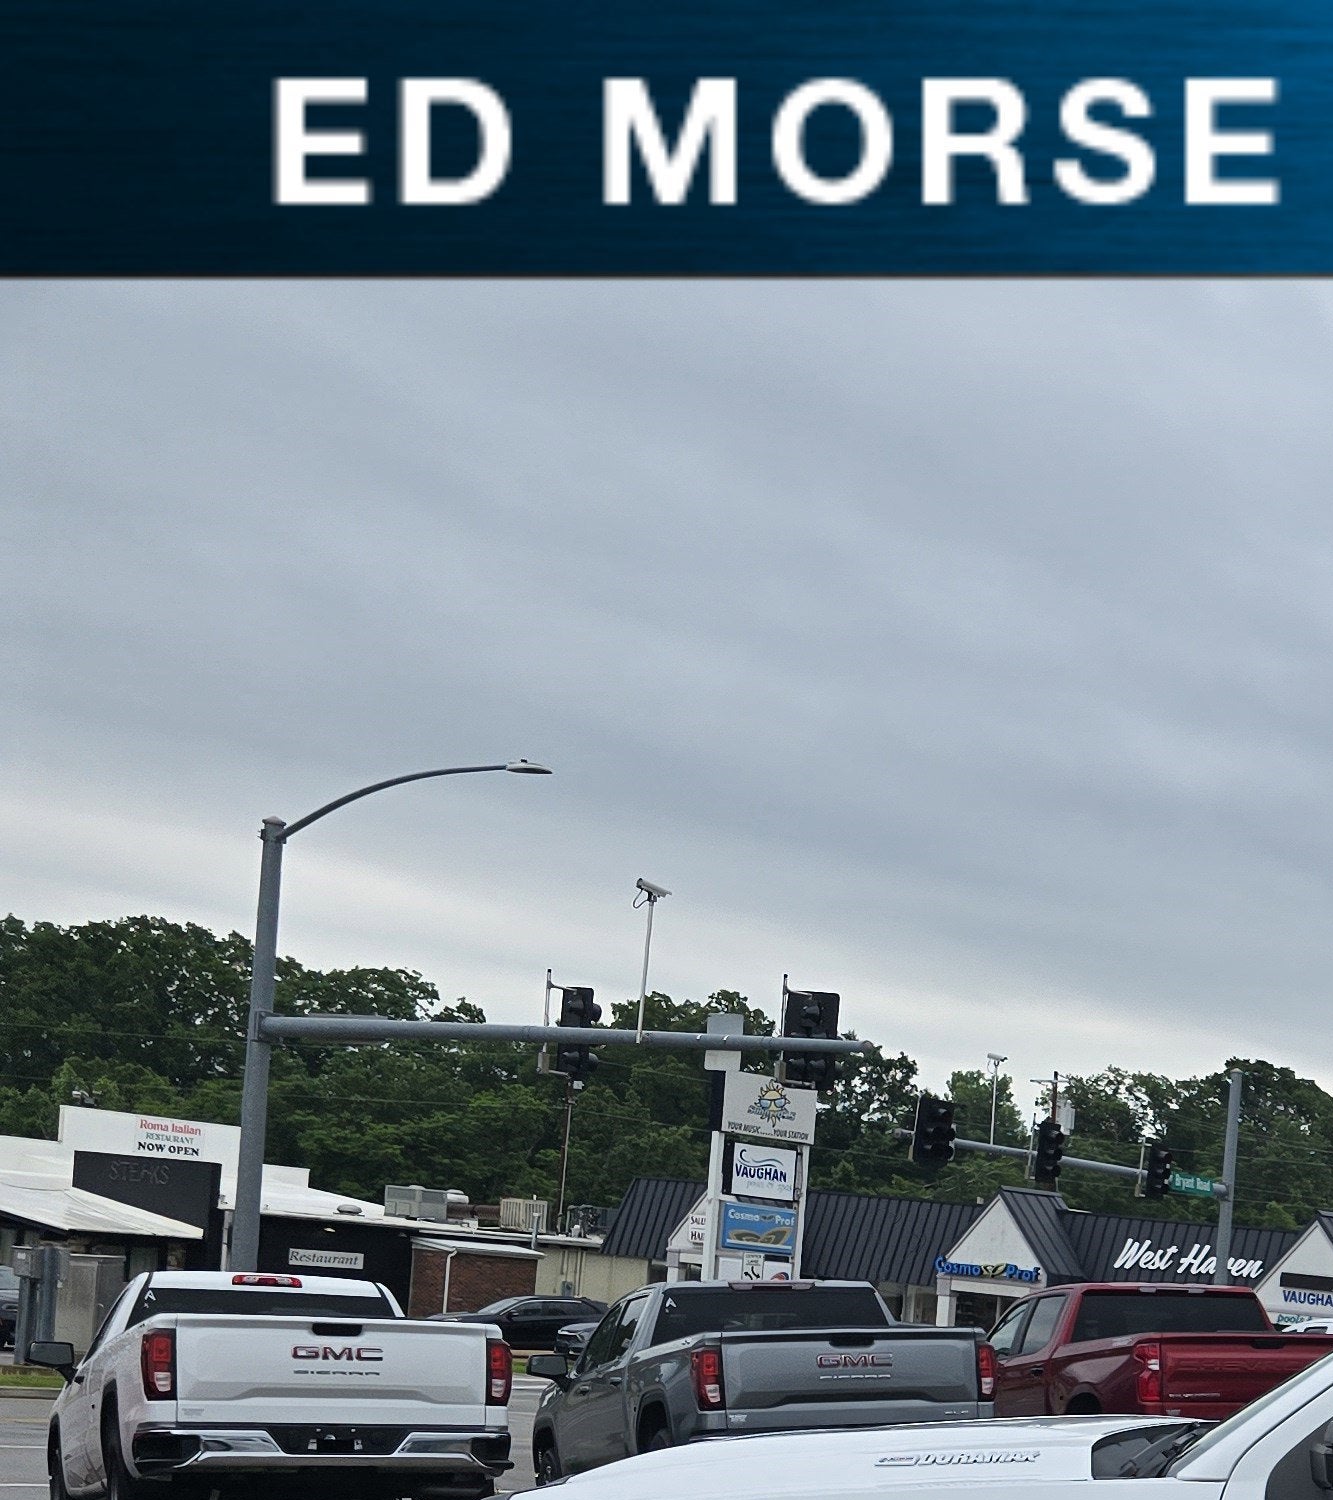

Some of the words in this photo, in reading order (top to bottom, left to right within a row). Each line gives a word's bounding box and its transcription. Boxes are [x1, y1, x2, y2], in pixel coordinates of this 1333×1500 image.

[140, 1119, 168, 1132] Roma
[171, 1123, 201, 1136] Italian
[728, 1121, 743, 1131] YOUR
[788, 1131, 809, 1140] STATION
[146, 1132, 194, 1144] RESTAURANT
[138, 1141, 166, 1152] NOW
[168, 1145, 200, 1156] OPEN
[735, 1164, 787, 1183] VAUGHAN
[1175, 1174, 1195, 1190] Bryant
[1197, 1177, 1211, 1191] Road
[728, 1209, 760, 1221] Cosmo
[775, 1215, 795, 1226] Prof
[290, 1250, 359, 1265] Restaurant
[1113, 1238, 1178, 1270] West
[934, 1255, 981, 1276] Cosmo
[1004, 1263, 1040, 1283] Prof
[291, 1345, 384, 1361] GMC
[816, 1353, 893, 1368] GMC
[918, 1451, 1041, 1466] DURAMAX
